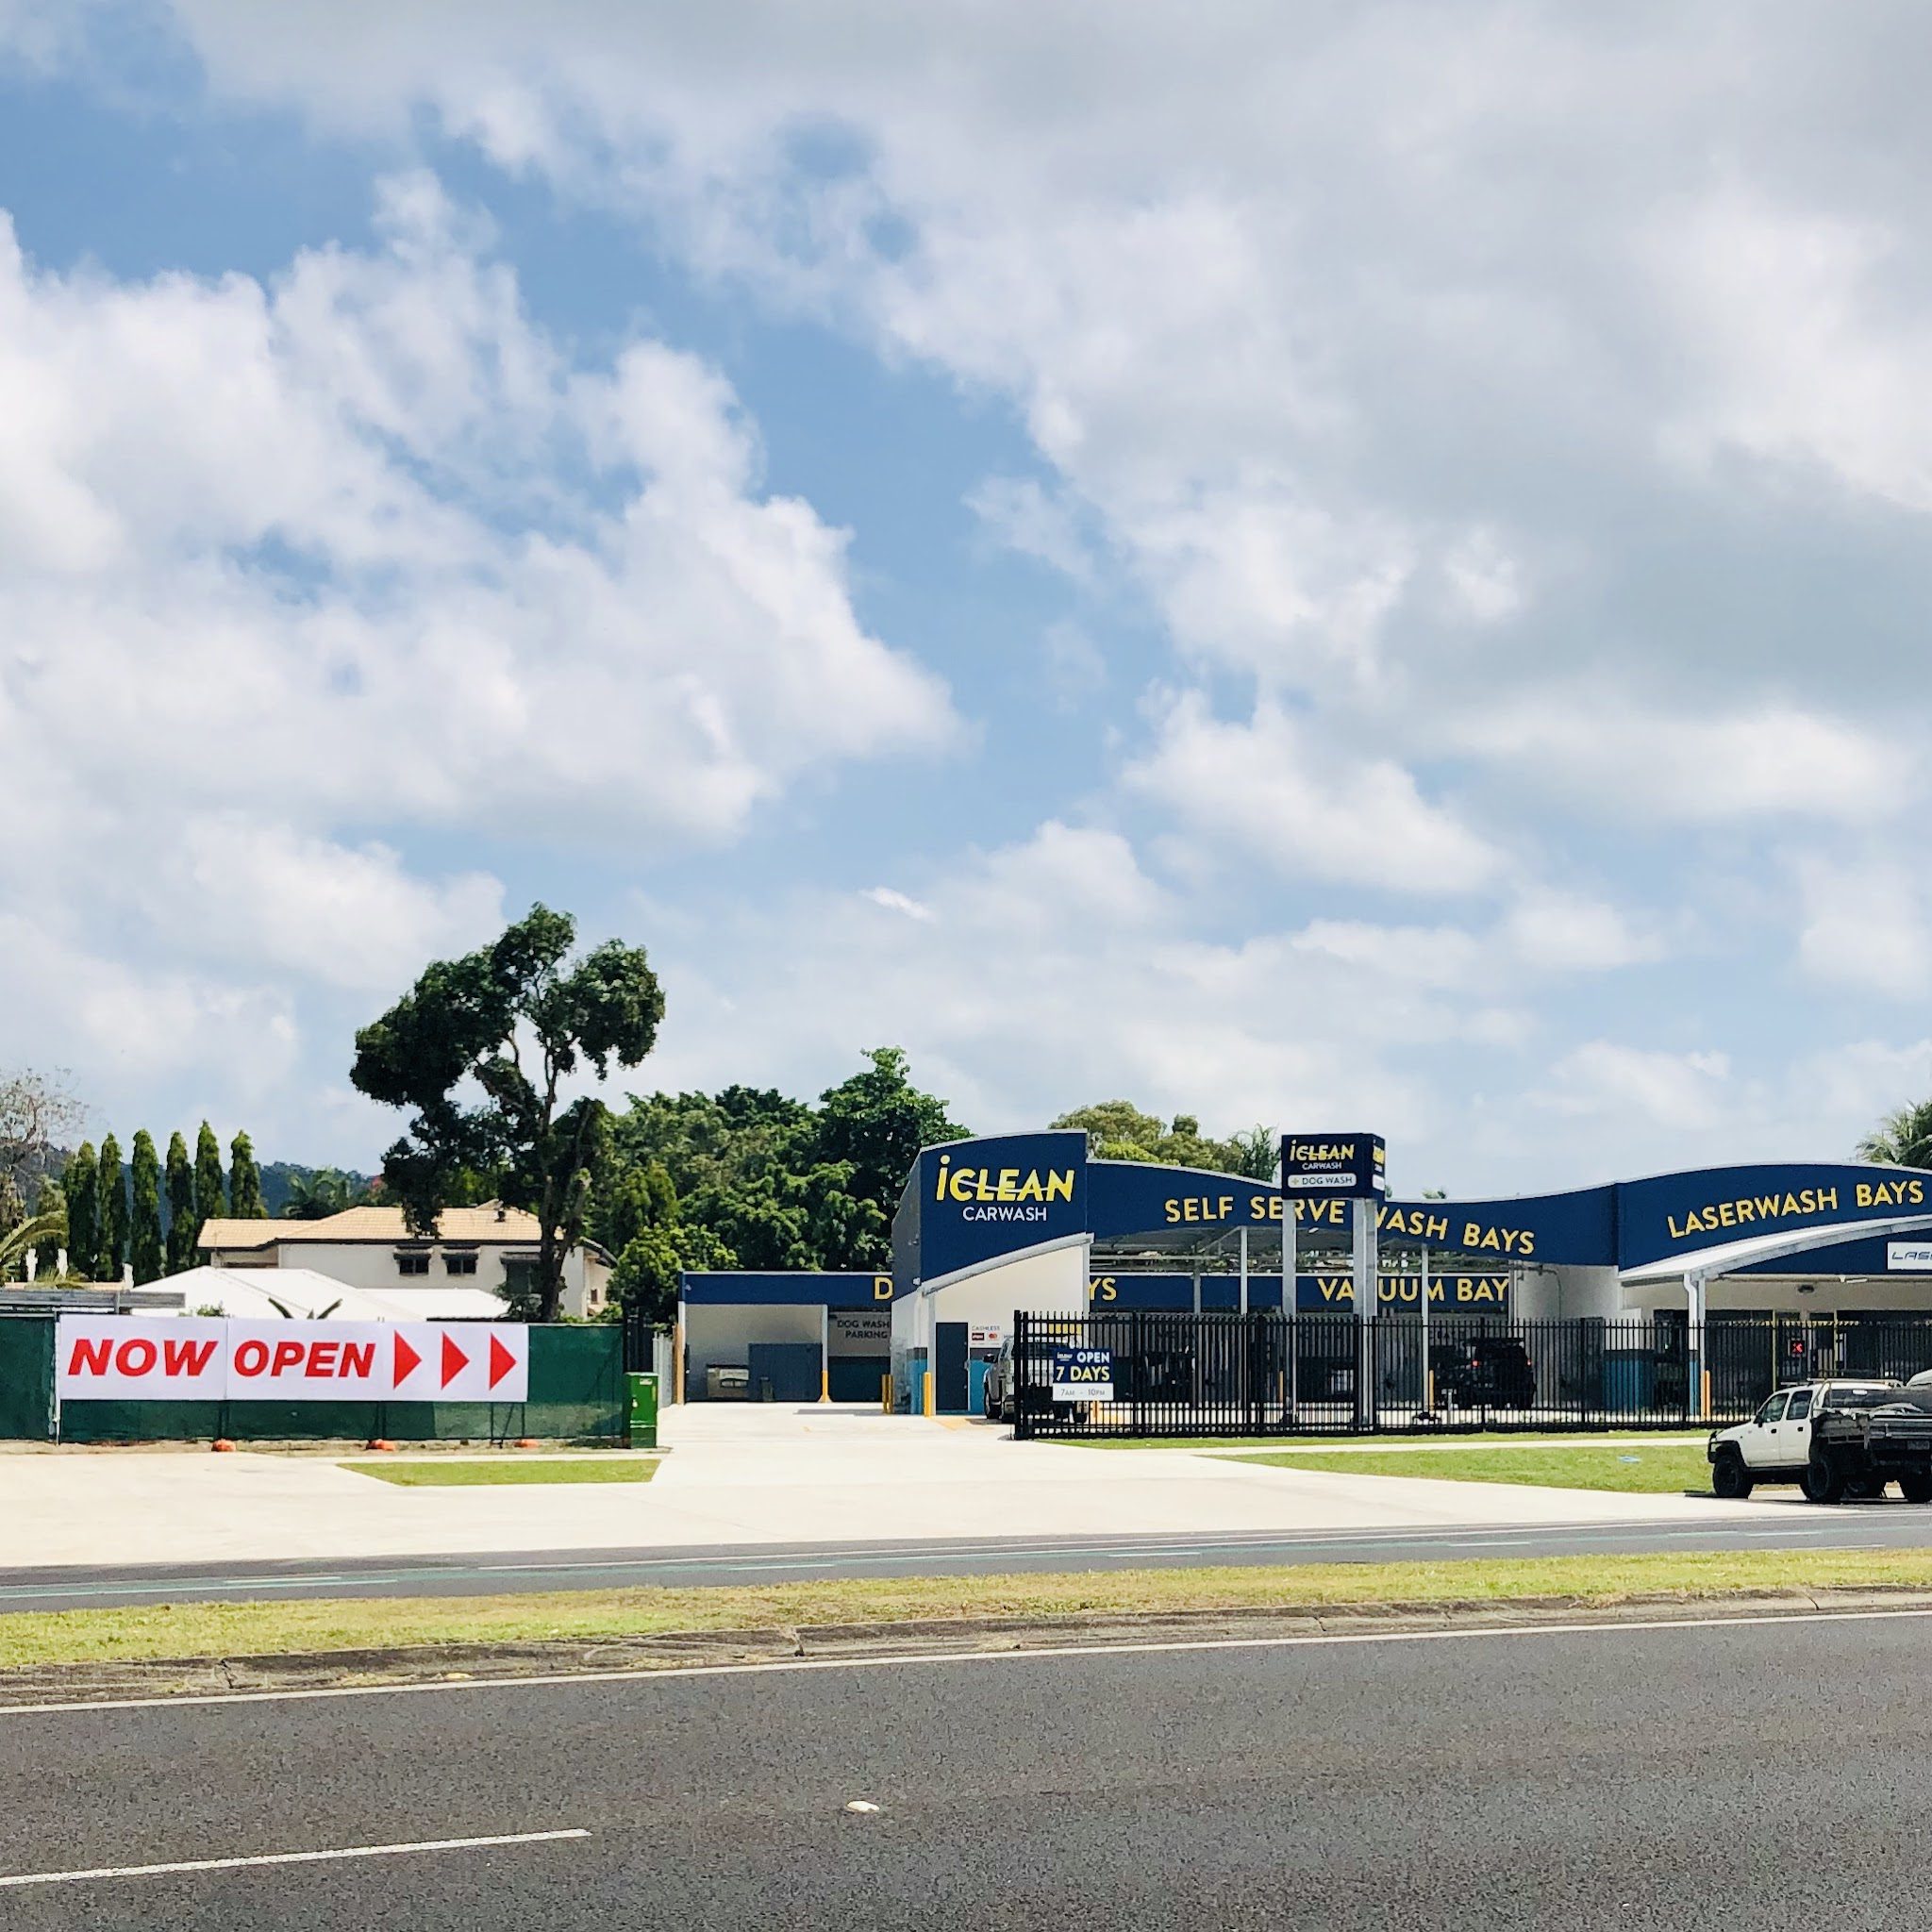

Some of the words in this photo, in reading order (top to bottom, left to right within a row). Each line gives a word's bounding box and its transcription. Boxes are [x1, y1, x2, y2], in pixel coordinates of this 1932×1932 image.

[1302, 1162, 1342, 1171] CARWASH
[936, 1155, 1074, 1202] iCLEAN
[1302, 1176, 1324, 1185] DOG
[1325, 1176, 1353, 1185] WASH
[962, 1207, 1047, 1222] CARWASH
[1667, 1187, 1838, 1239] LASERWASH
[1856, 1180, 1924, 1208] BAYS
[1165, 1196, 1234, 1223] SELF
[1250, 1196, 1346, 1224] SERVE
[1463, 1223, 1535, 1255] BAYS
[1891, 1251, 1932, 1260] LAS
[1317, 1278, 1444, 1302] VAUUM
[1457, 1278, 1508, 1302] BAY
[837, 1320, 859, 1328] DOG
[862, 1320, 890, 1328] WASH
[845, 1330, 888, 1339] PARKING
[67, 1338, 219, 1377] NOW
[233, 1340, 376, 1378] OPEN
[1076, 1351, 1110, 1363] OPEN
[1056, 1366, 1065, 1381] 7
[1070, 1366, 1110, 1381] DAYS
